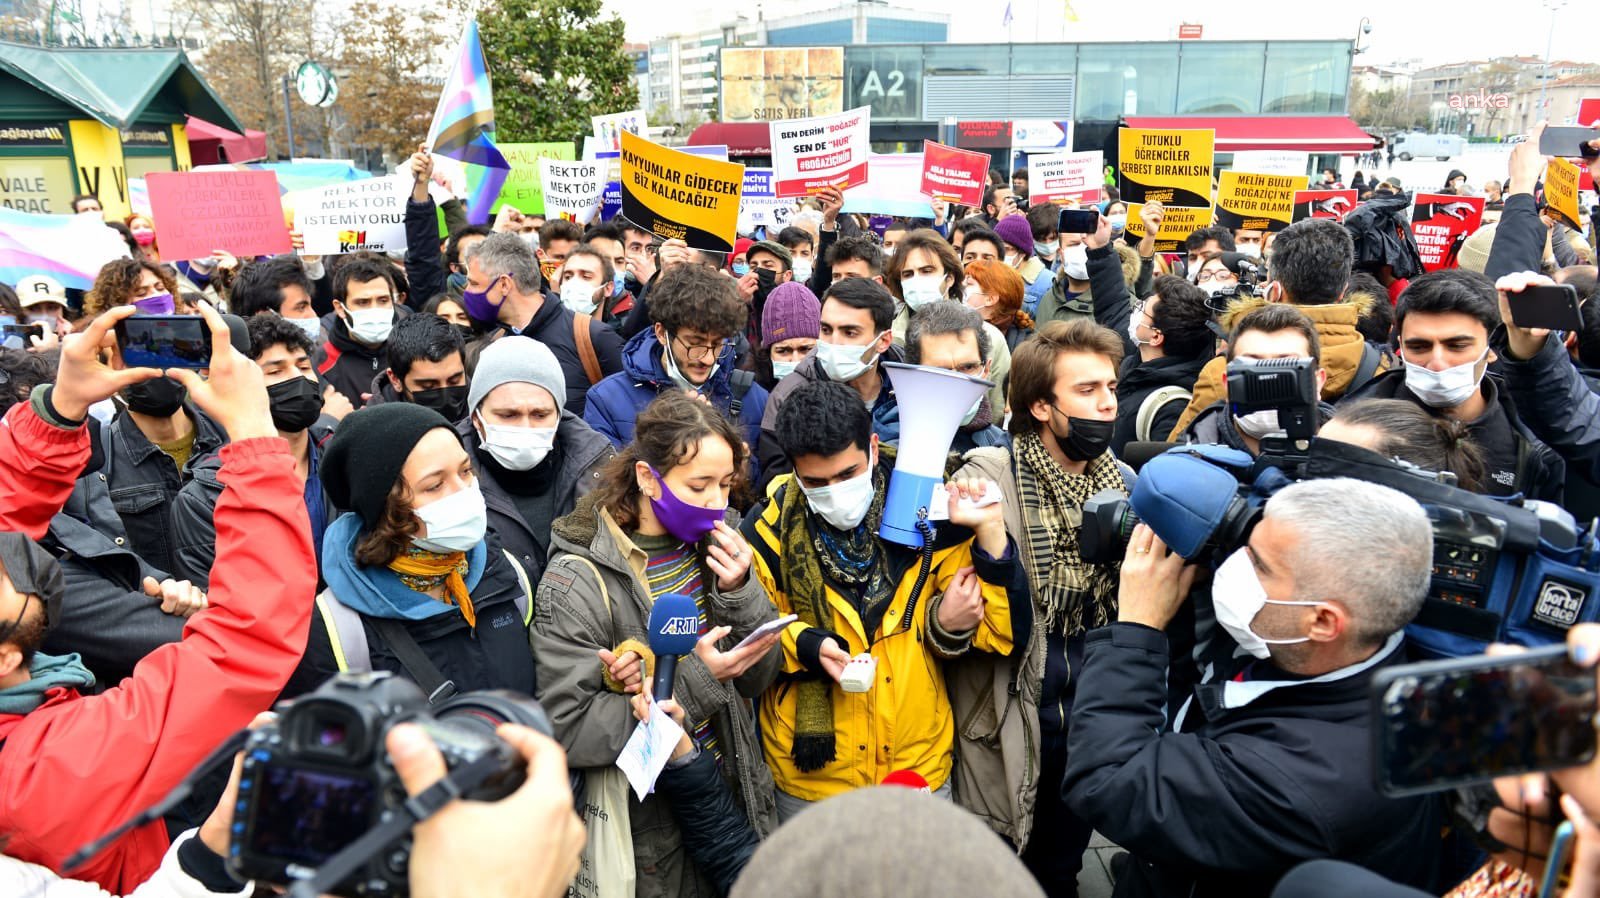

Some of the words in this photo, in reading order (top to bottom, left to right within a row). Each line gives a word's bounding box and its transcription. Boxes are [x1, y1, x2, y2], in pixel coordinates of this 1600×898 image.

[860, 70, 904, 97] A2
[781, 131, 798, 140] BEN
[799, 126, 825, 138] DERİM
[793, 143, 813, 154] SEN
[815, 141, 827, 151] DE
[1142, 134, 1182, 147] TUTUKLU
[1135, 146, 1190, 161] ÖĞRENCİLER
[549, 165, 596, 177] REKTÖR
[622, 148, 681, 185] KAYYUMLAR
[684, 172, 739, 196] GİDECEK
[1121, 162, 1153, 175] SERBEST
[1155, 164, 1210, 177] BIRAKILSIN
[743, 173, 767, 183] NCİYE
[1237, 174, 1265, 186] MELİH
[1268, 177, 1292, 188] BULU
[550, 181, 596, 194] MEKTÖR
[634, 172, 649, 189] BİZ
[652, 180, 718, 209] KALACAĞIZ!
[743, 183, 767, 193] EMİYE
[1222, 197, 1257, 211] REKTÖR
[1260, 202, 1291, 213] OLAMA
[1163, 213, 1195, 223] ENCİLER
[1415, 224, 1450, 236] KAYYUM
[34, 282, 49, 294] R
[1542, 590, 1578, 611] porta
[1539, 603, 1574, 621] brace
[660, 617, 698, 635] ARTI
